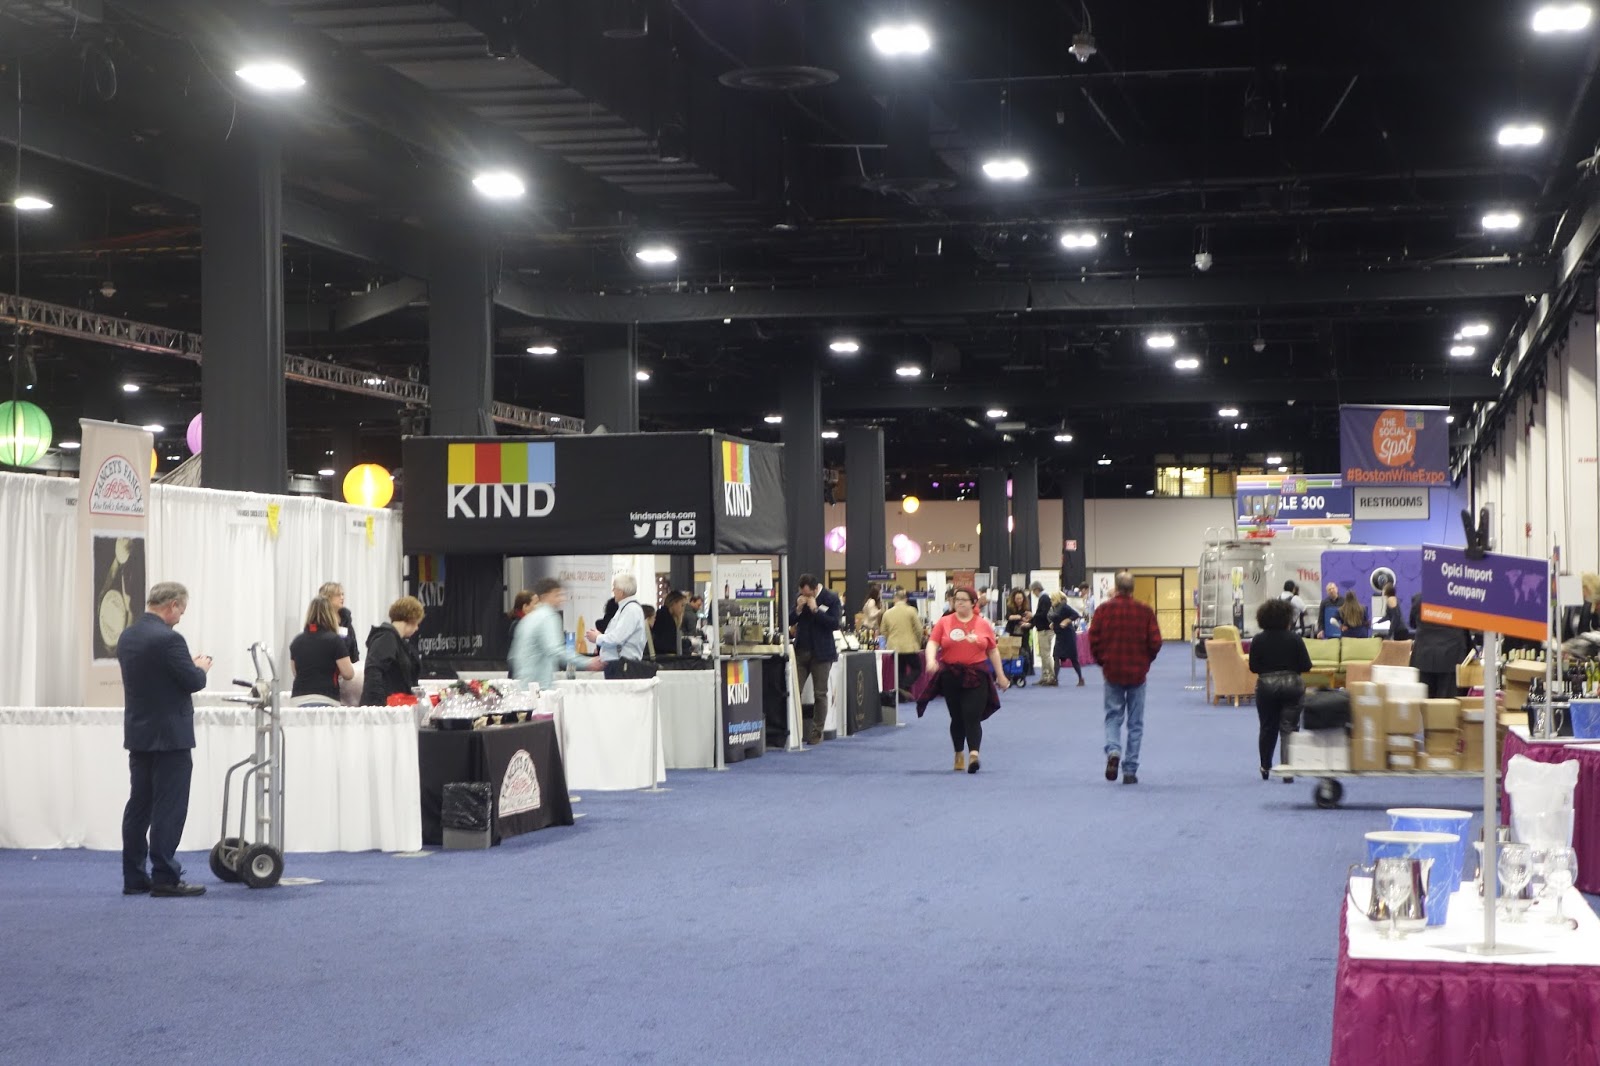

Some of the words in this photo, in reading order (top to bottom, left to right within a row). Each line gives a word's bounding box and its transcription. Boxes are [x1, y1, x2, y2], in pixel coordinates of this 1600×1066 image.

[1379, 426, 1406, 437] SOCIAL
[1382, 418, 1397, 426] THE
[124, 464, 143, 503] FANCY
[1346, 466, 1446, 485] #BostonWineExpo
[447, 482, 556, 518] KIND
[724, 482, 752, 517] KIND
[1301, 496, 1325, 510] 300
[1360, 496, 1423, 507] RESTROOMS
[629, 511, 696, 521] kindsnacks.com
[1423, 549, 1437, 562] 275
[1296, 568, 1320, 582] This
[1441, 562, 1463, 578] Opici
[1464, 565, 1493, 583] Import
[418, 582, 446, 607] KIND
[1447, 581, 1487, 602] Company
[458, 636, 471, 653] you
[471, 634, 483, 648] can
[728, 683, 749, 706] KIND
